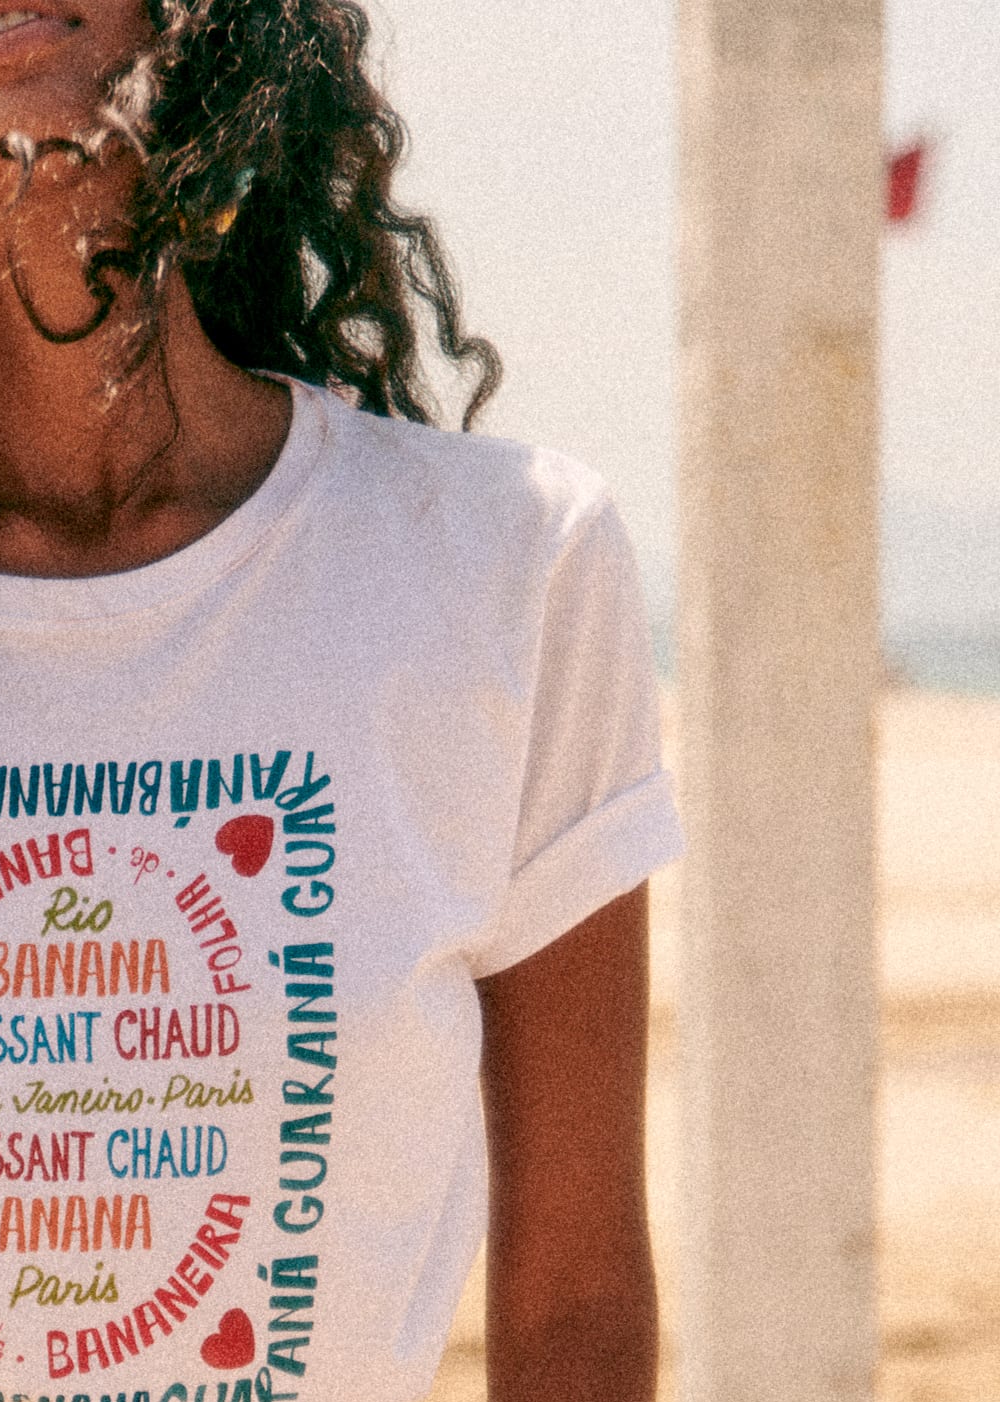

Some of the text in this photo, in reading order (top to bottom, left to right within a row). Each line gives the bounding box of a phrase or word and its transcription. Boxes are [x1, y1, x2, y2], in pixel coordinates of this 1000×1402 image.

[42, 886, 114, 936] Rio
[130, 846, 252, 996] FOLHA de
[113, 1003, 241, 1061] CHAUD
[159, 1069, 256, 1112] Paris
[269, 943, 337, 1233] GUARANÁ
[106, 1125, 228, 1179] CHAUD
[9, 1262, 119, 1309] Paris
[46, 1193, 251, 1380] BANANEIRA
